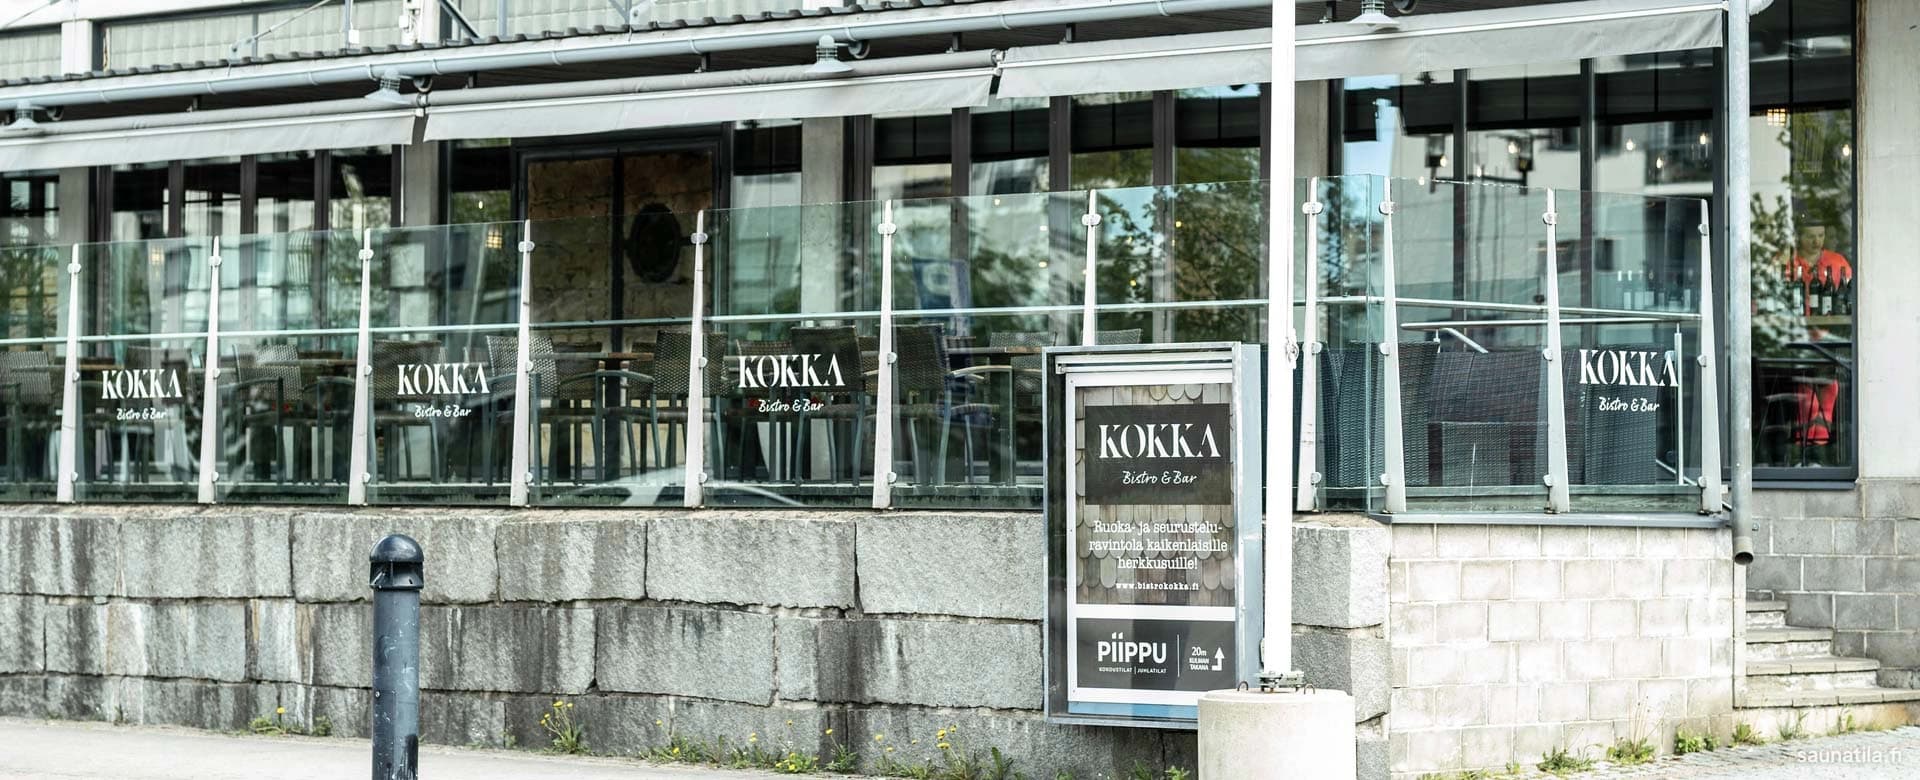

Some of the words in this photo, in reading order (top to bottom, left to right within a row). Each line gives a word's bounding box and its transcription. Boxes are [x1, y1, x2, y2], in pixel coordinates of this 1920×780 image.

[738, 353, 846, 388] KOKKA
[1579, 349, 1679, 387] KOKKA
[102, 368, 183, 400] KOKKA
[397, 363, 490, 395] KOKKA
[414, 404, 442, 418] Bistro
[443, 405, 453, 418] &
[452, 404, 472, 418] Bar
[758, 398, 790, 413] Bistro
[792, 399, 802, 413] &
[802, 398, 824, 412] Bar
[1599, 396, 1628, 411] Bistro
[1630, 398, 1639, 412] &
[1640, 398, 1660, 412] Bar
[116, 407, 140, 420] Bistro
[142, 408, 149, 420] &
[149, 407, 167, 420] Bar
[1098, 423, 1222, 459] KOKKA
[1121, 470, 1158, 485] Bistro
[1161, 471, 1172, 485] &
[1172, 470, 1198, 485] Bar
[1093, 520, 1136, 534] Ruoka-
[1138, 521, 1151, 536] ja
[1153, 520, 1223, 534] seurustelu-
[1089, 538, 1144, 552] ravintola
[1146, 538, 1228, 552] kaikenlaisille
[1116, 556, 1198, 570] herkkusuille!
[1115, 582, 1200, 591] www.bistrokokka.fi
[1191, 646, 1207, 657] 20m
